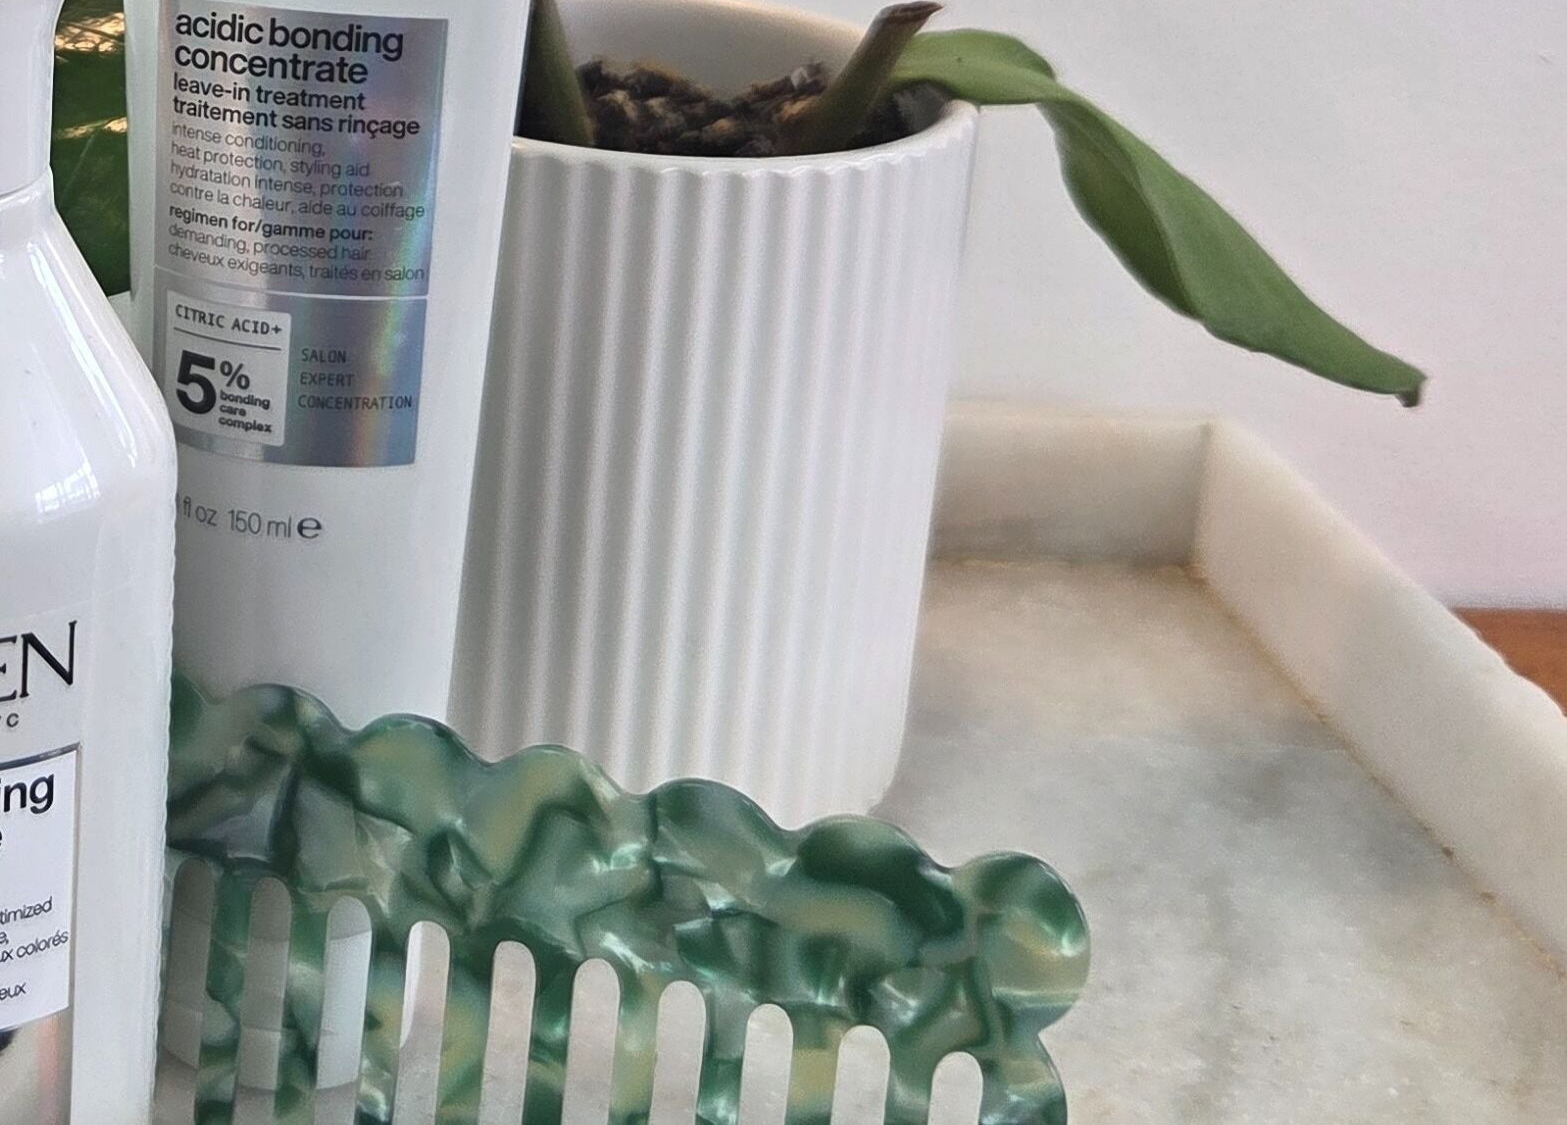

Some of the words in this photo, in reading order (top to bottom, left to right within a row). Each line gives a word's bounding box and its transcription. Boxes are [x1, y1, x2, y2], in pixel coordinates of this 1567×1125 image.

[176, 12, 263, 45] acidic
[269, 18, 404, 61] bonding
[175, 44, 368, 83] concentrate
[173, 72, 250, 102] leave-in
[256, 84, 365, 110] treatment
[173, 95, 278, 127] traitement
[282, 113, 332, 131] sans
[338, 115, 419, 139] rinçage
[172, 123, 221, 144] intense
[171, 142, 200, 159] heat
[290, 159, 341, 177] styling
[347, 164, 369, 176] aid
[170, 161, 250, 187] hydratation
[320, 184, 403, 199] protection
[170, 181, 213, 201] contre
[217, 189, 229, 204] la
[298, 201, 332, 216] aide
[337, 204, 356, 216] au
[361, 202, 424, 221] coiffage
[169, 204, 227, 227] regimen
[330, 227, 373, 242] pour:
[168, 243, 224, 267] cheveux
[309, 265, 357, 280] traités
[361, 268, 381, 280] en
[384, 266, 424, 281] salon
[253, 241, 337, 259] processed
[341, 245, 370, 260] hair
[175, 305, 224, 328] CITRIC
[232, 319, 281, 335] ACID+
[302, 349, 347, 363] SALON
[300, 372, 353, 387] EXPERT
[219, 405, 246, 417] care
[220, 390, 270, 410] bonding
[298, 395, 412, 409] CONCENTRATION
[219, 416, 272, 433] complex
[196, 505, 217, 526] oz
[227, 510, 261, 534] 150
[267, 516, 291, 538] ml
[16, 929, 69, 959] colorés
